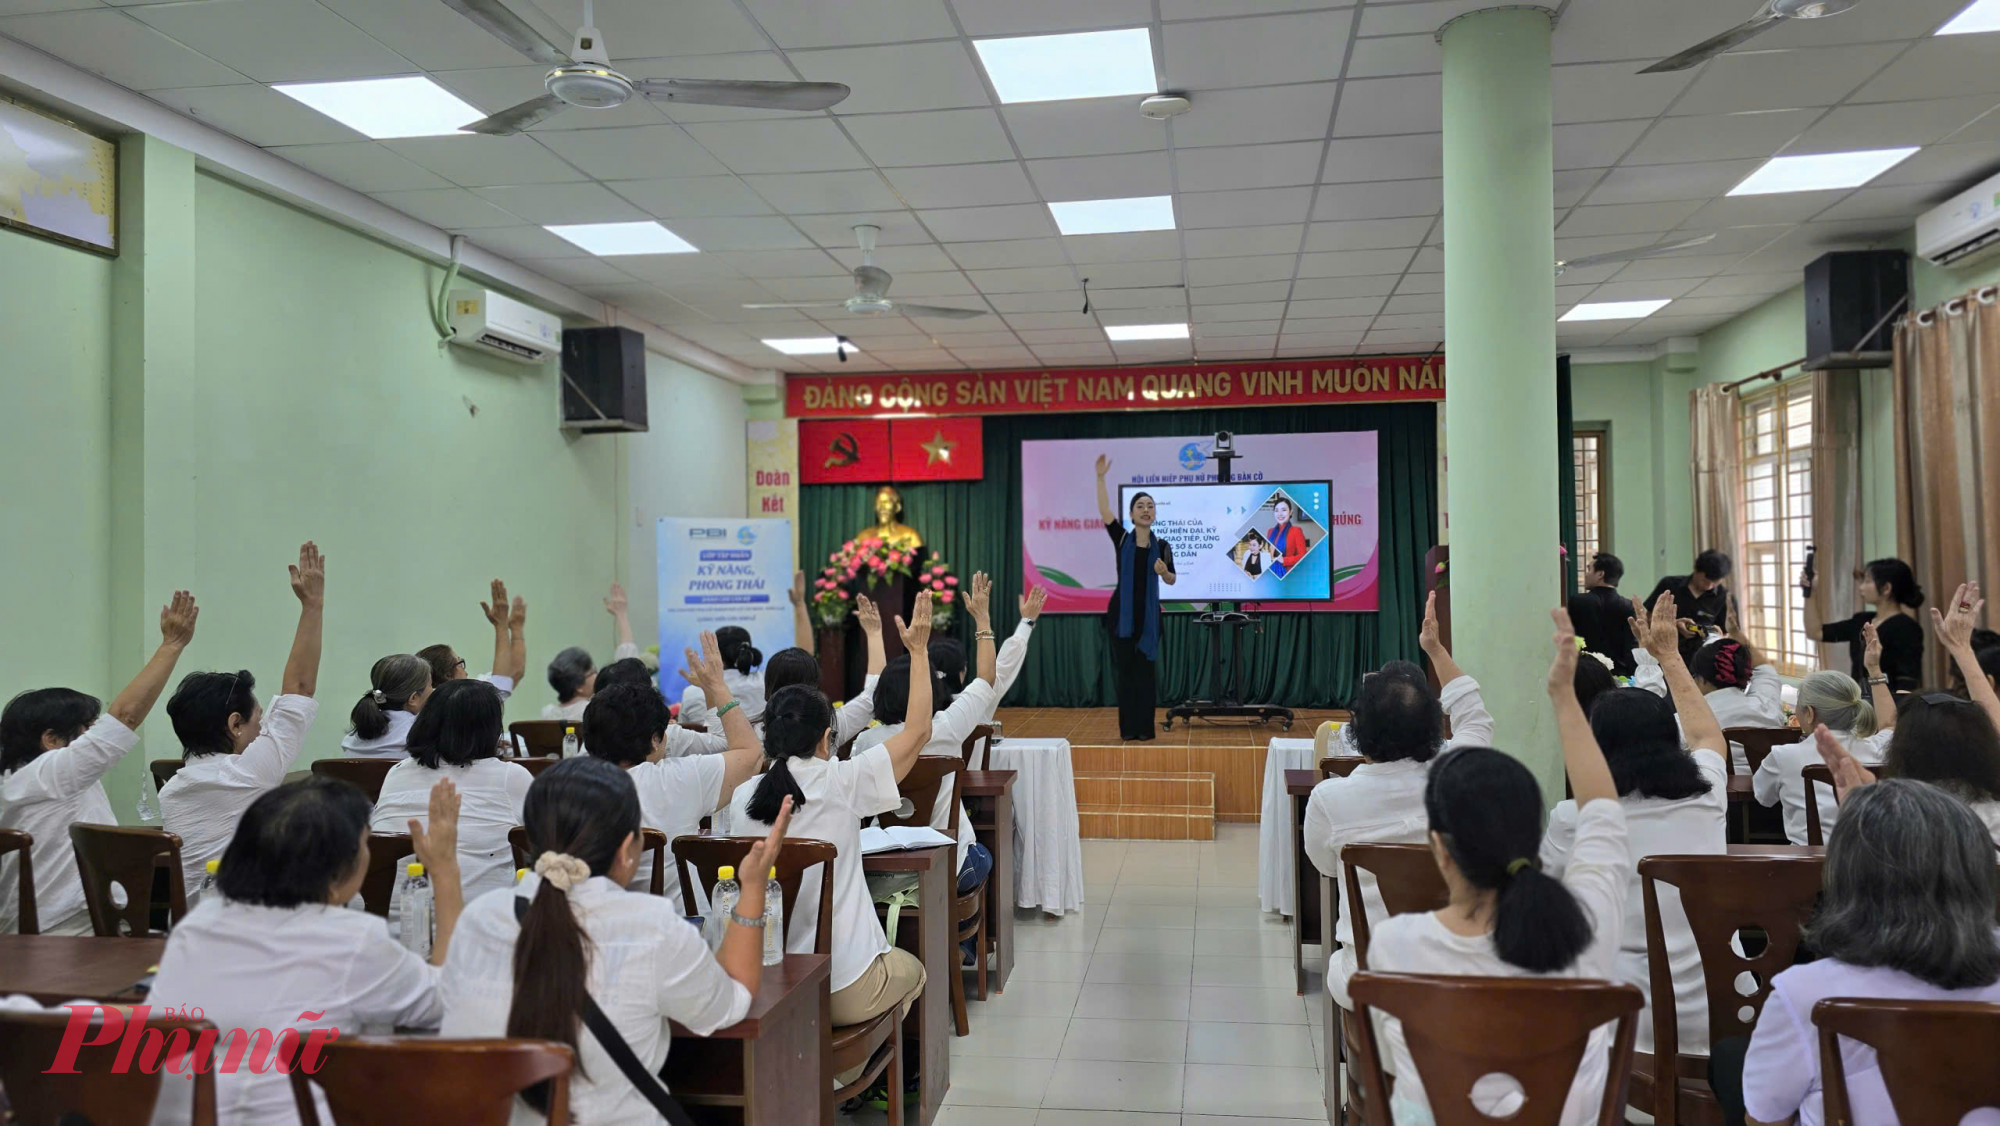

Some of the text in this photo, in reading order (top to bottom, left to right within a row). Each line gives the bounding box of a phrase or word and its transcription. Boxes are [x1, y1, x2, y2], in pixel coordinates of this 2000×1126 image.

[803, 377, 873, 409] ĐẢNG
[879, 378, 949, 413] CỘNG
[956, 372, 1006, 404] SẢN
[1014, 372, 1069, 409] VIỆT
[1077, 375, 1134, 402] NAM
[1141, 371, 1232, 402] QUANG
[1240, 369, 1303, 397] VINH
[1312, 361, 1390, 394] MUÔN
[755, 469, 790, 486] Đoàn
[761, 493, 784, 512] Kết
[688, 577, 766, 590] PHONG THÁI
